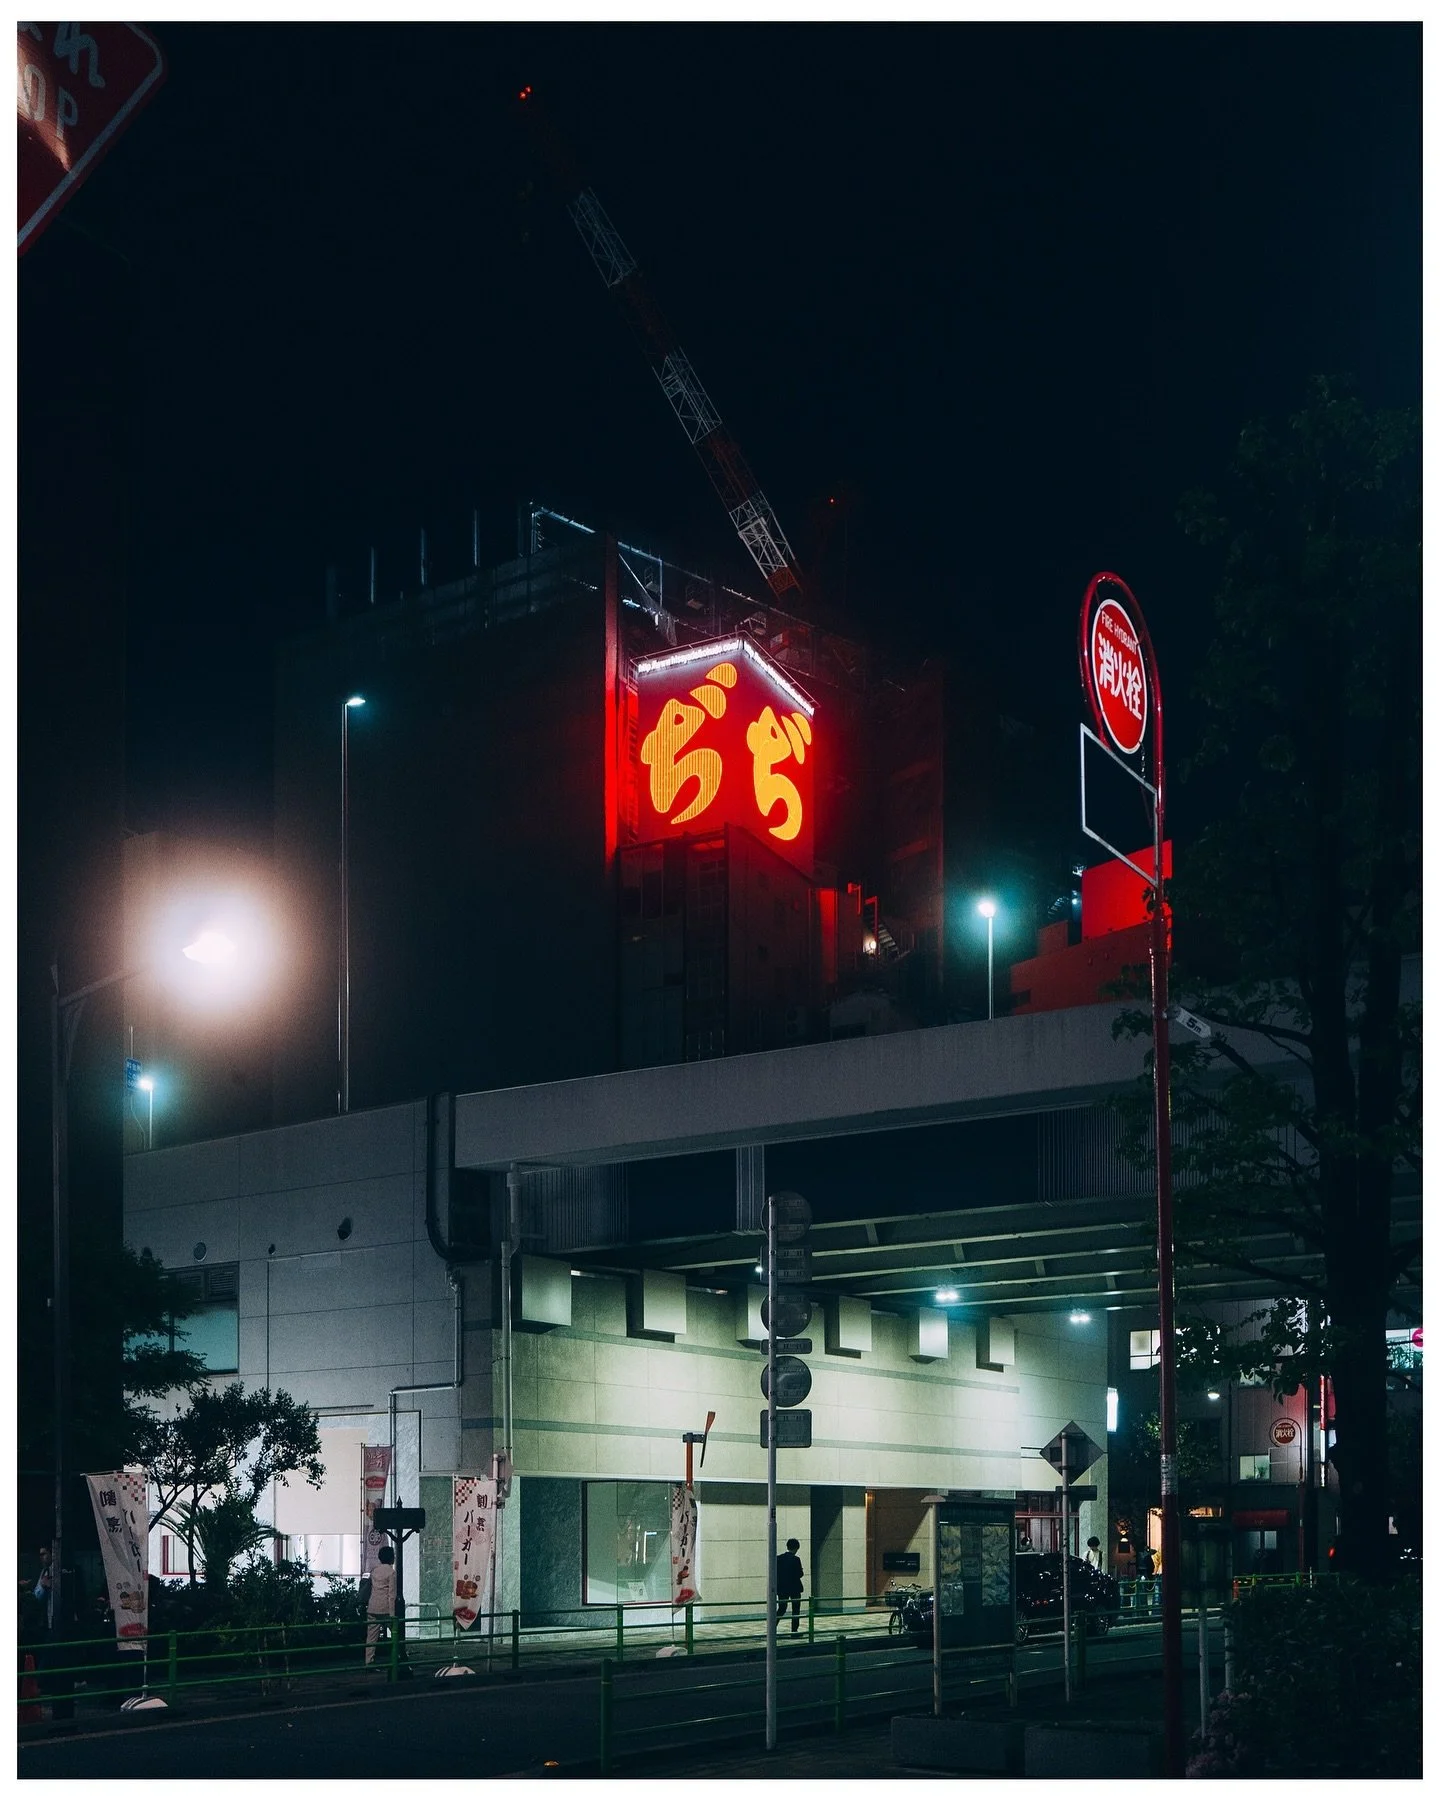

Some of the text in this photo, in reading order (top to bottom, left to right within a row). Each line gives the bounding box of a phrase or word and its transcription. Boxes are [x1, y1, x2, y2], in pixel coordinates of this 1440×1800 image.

[1098, 631, 1143, 721] 消火栓
[1101, 610, 1138, 656] FIRE HYDRANT
[640, 662, 738, 825] ぢ
[746, 705, 812, 841] ぢ
[461, 1509, 474, 1565] バーガー
